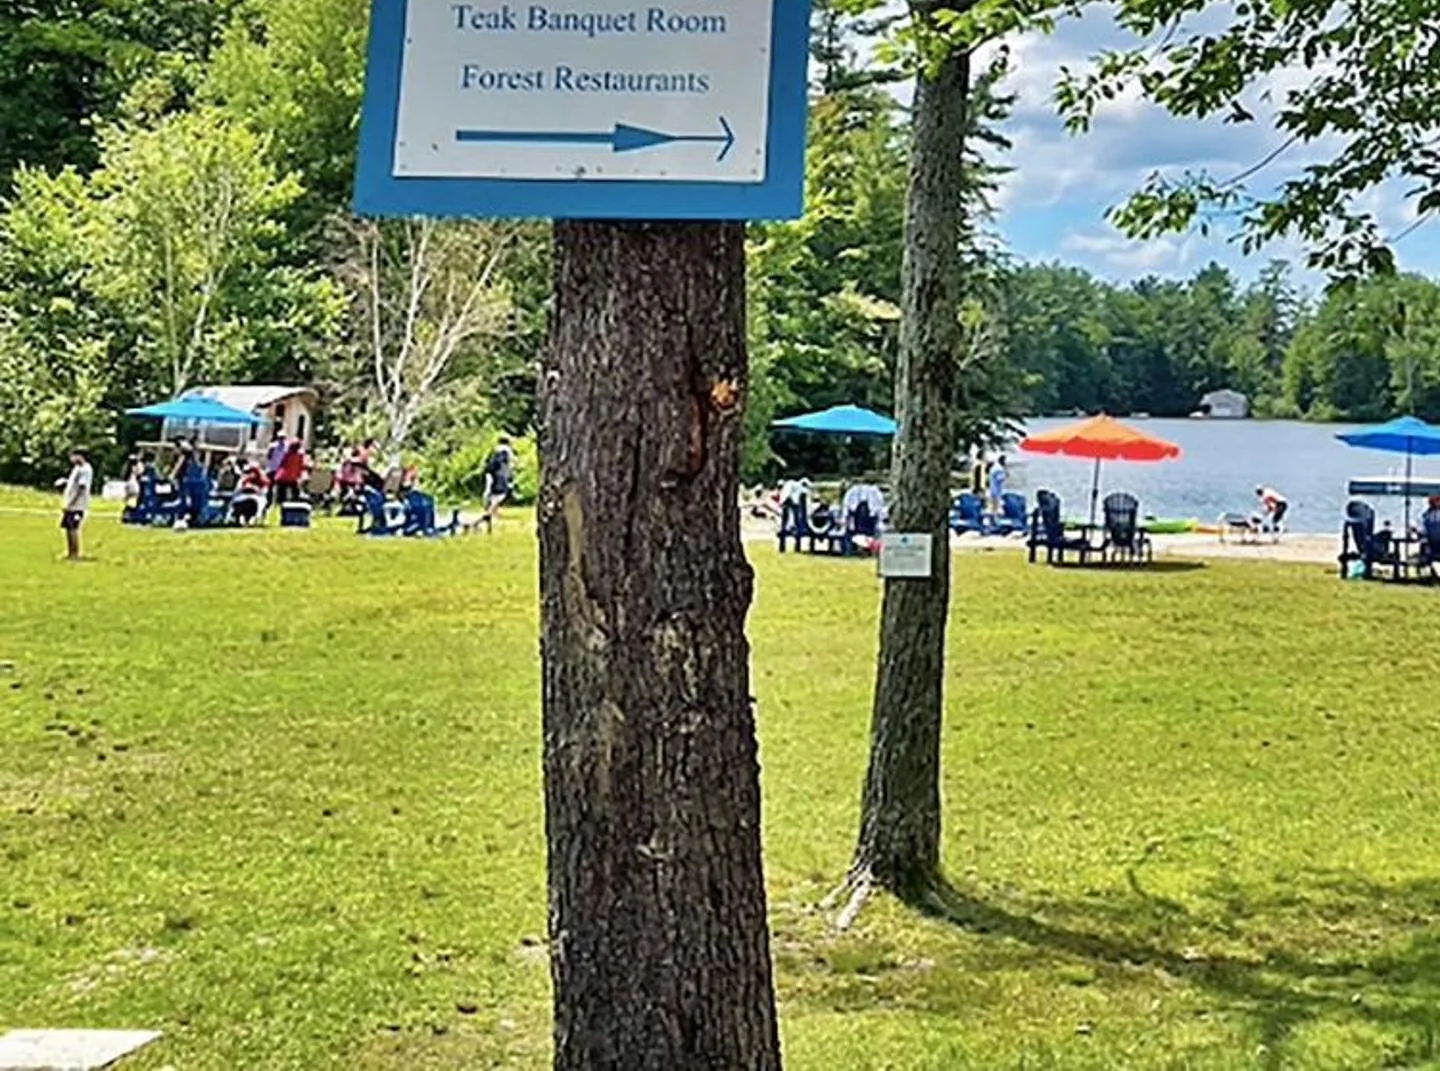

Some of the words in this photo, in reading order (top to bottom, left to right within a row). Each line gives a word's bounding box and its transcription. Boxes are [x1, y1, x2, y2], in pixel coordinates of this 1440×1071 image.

[452, 5, 516, 30] Teak
[527, 4, 637, 38] Banquet
[646, 7, 727, 33] Room
[461, 64, 544, 90] Forest
[554, 65, 710, 93] Restaurants
